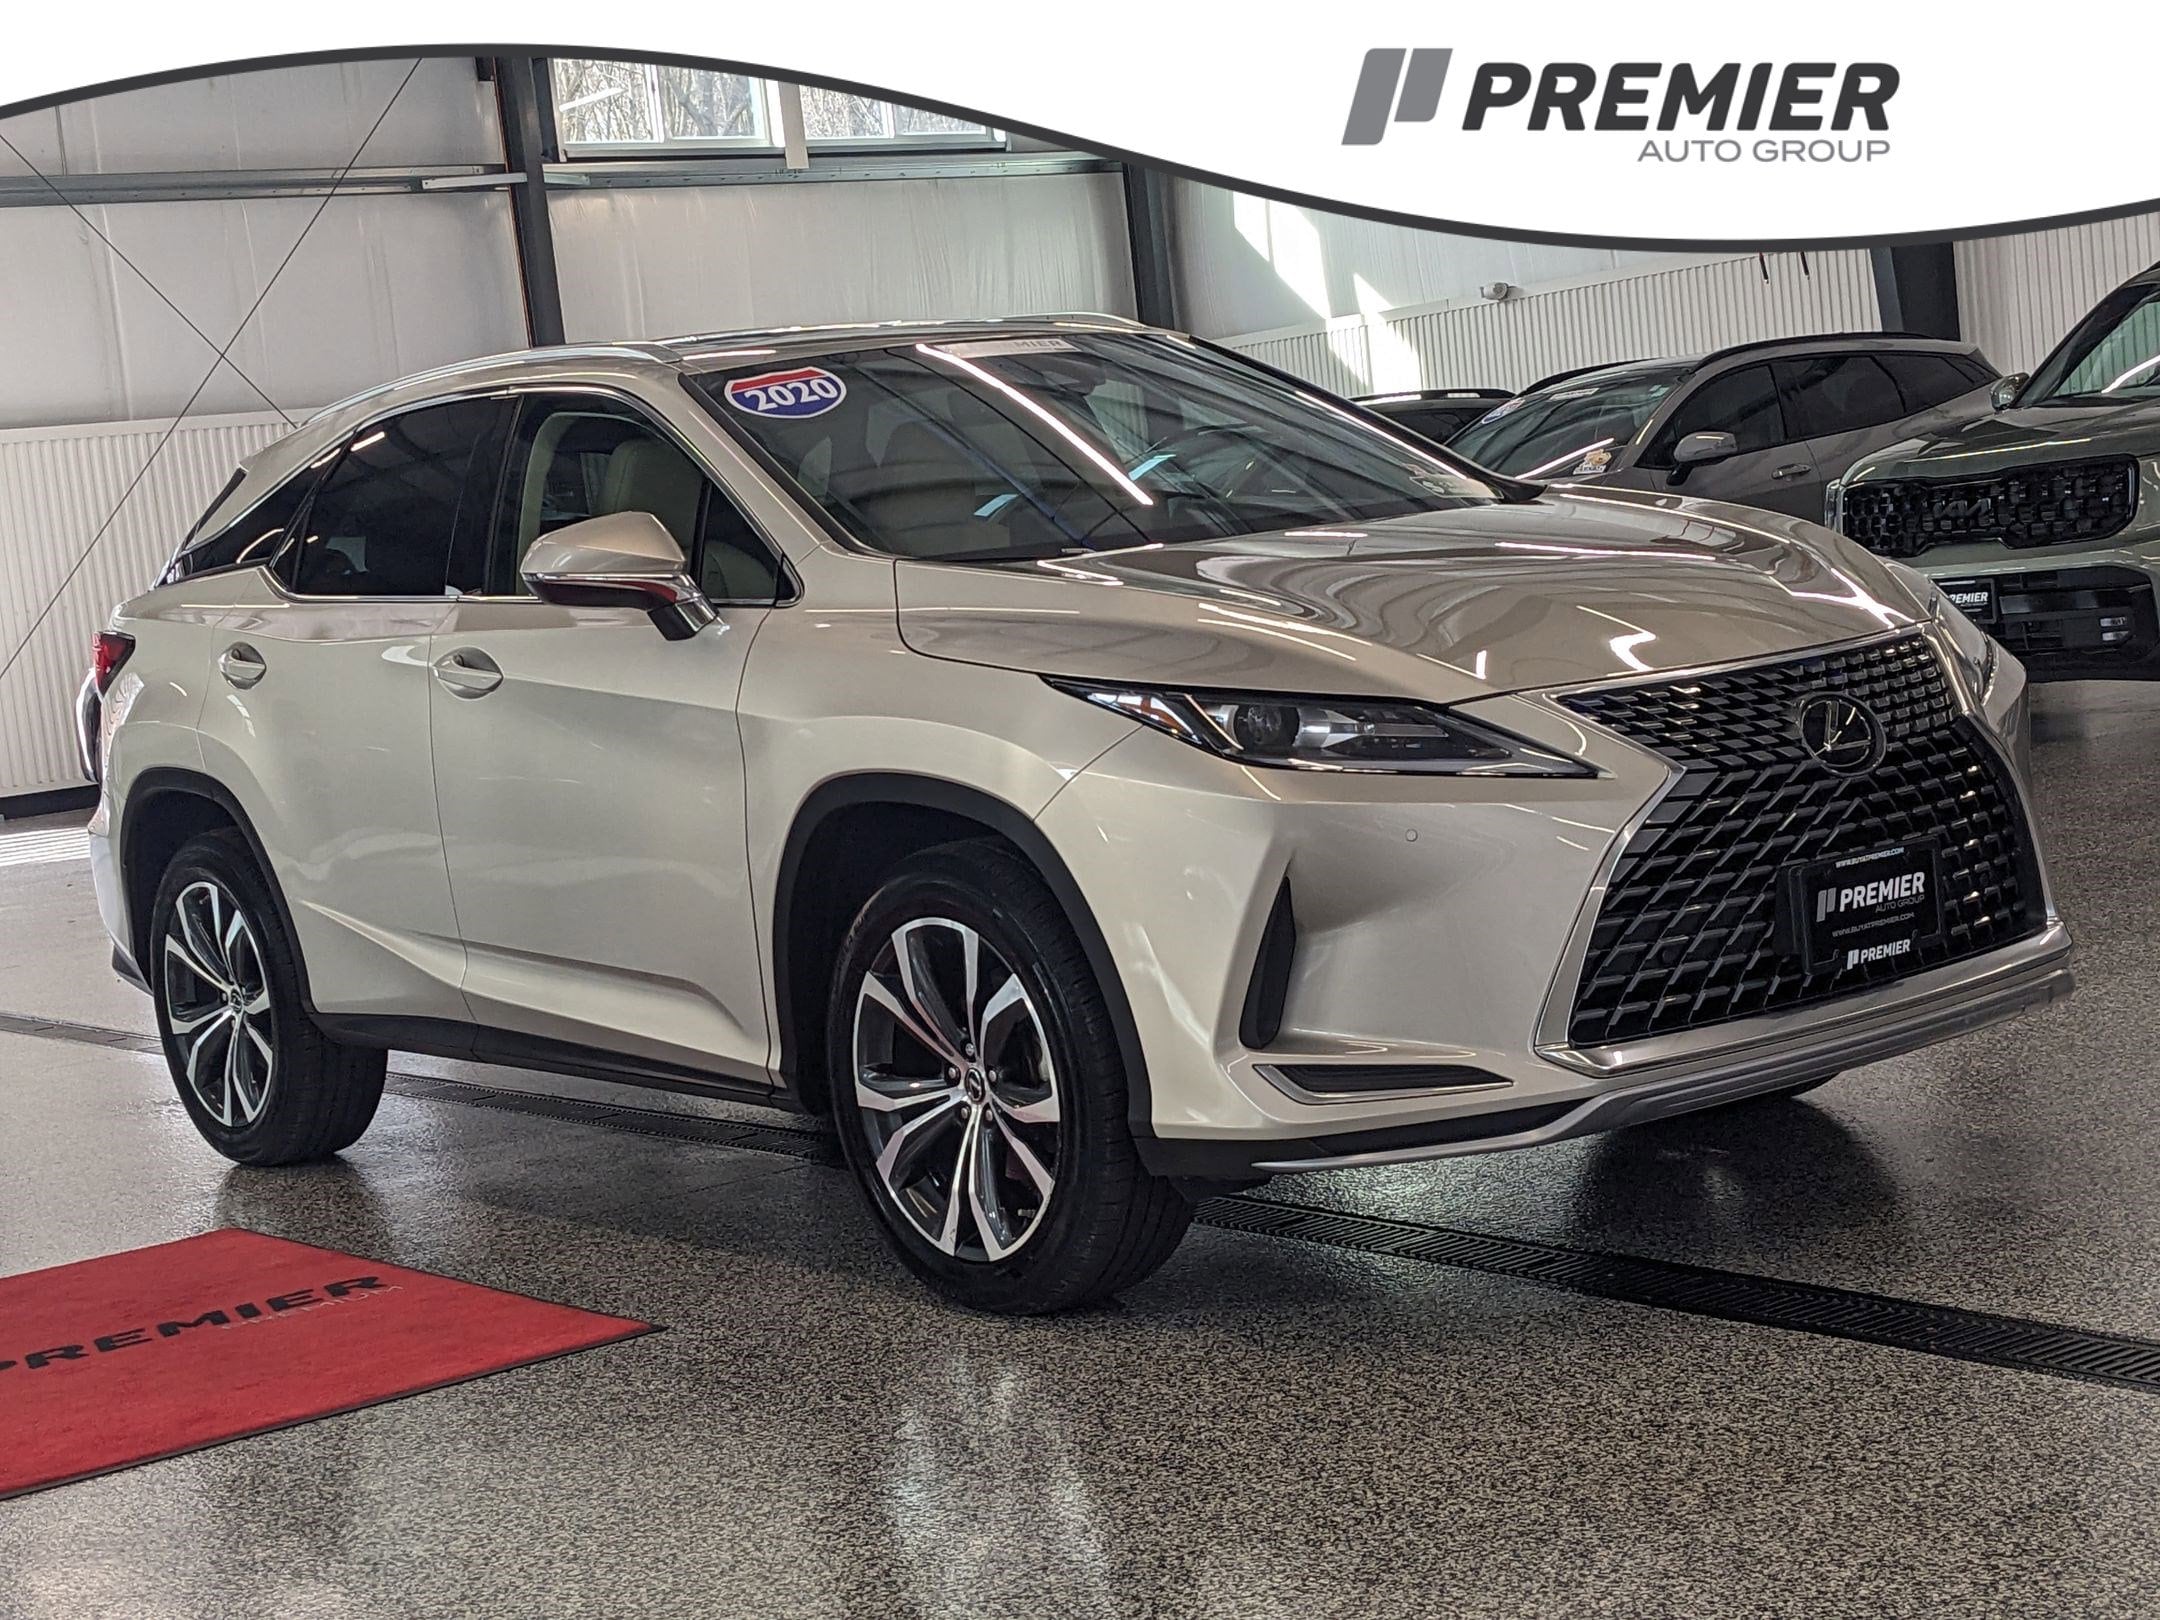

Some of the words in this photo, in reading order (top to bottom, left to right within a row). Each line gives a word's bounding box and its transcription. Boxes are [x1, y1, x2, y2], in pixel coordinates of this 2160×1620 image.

[744, 379, 838, 411] 2020
[1839, 872, 1925, 912] PREMIER
[1875, 901, 1897, 914] AUTO
[1898, 894, 1925, 907] GROUP
[1860, 938, 1911, 964] PREMIER
[0, 1276, 388, 1370] REMIER
